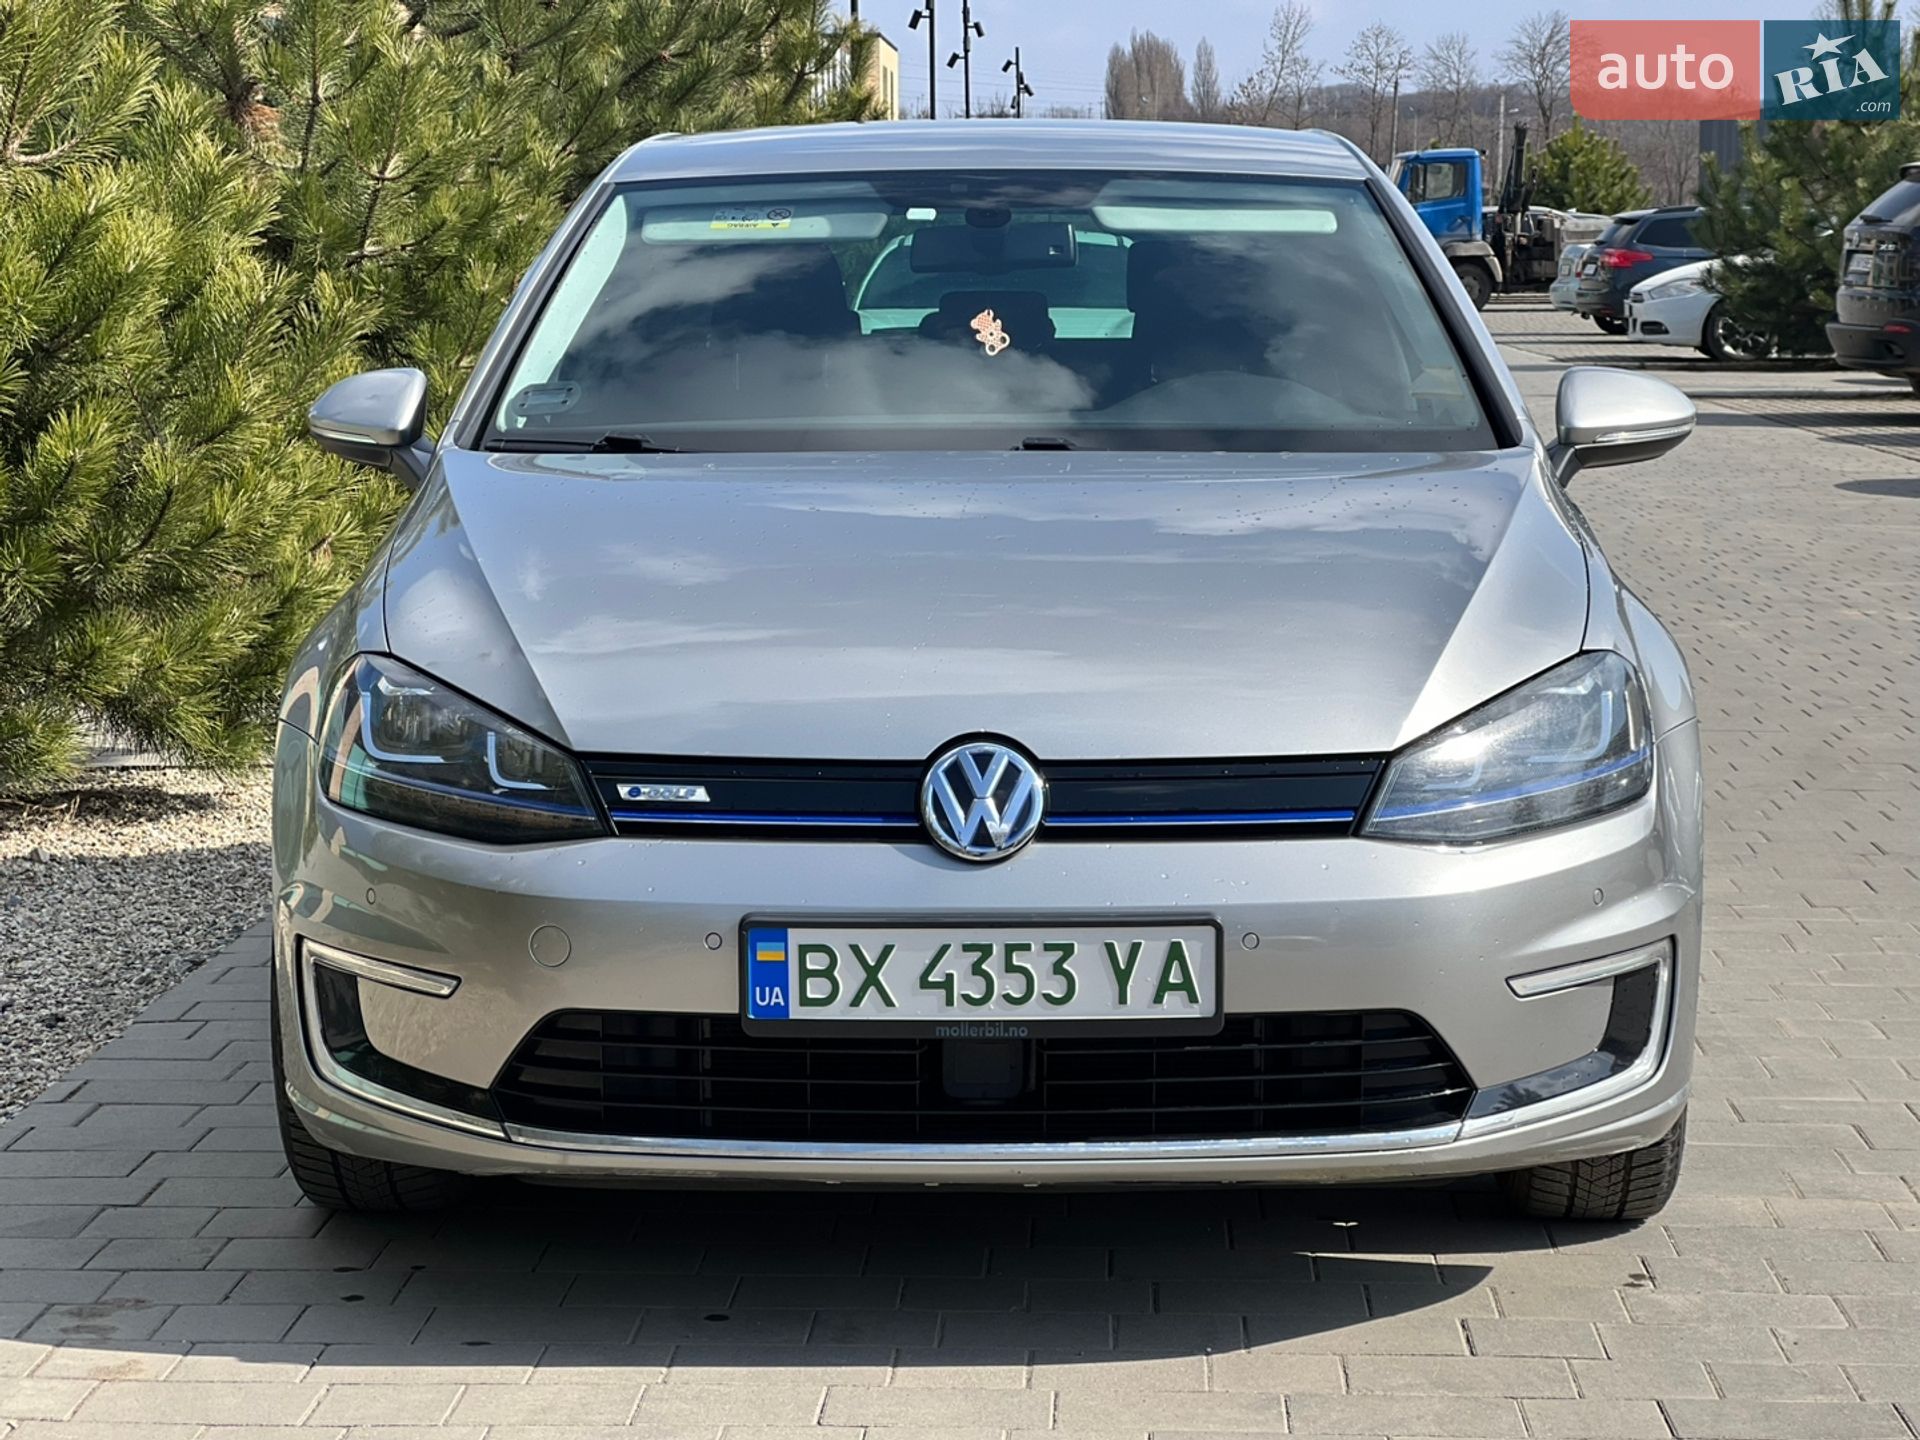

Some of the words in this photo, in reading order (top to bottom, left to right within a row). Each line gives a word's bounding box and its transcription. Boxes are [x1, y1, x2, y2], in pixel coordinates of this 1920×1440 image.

[798, 943, 899, 1008] BX
[918, 942, 1079, 1008] 4353
[1103, 939, 1202, 1006] YA
[755, 986, 785, 1007] UA
[935, 1021, 1029, 1037] mollerbil.no
